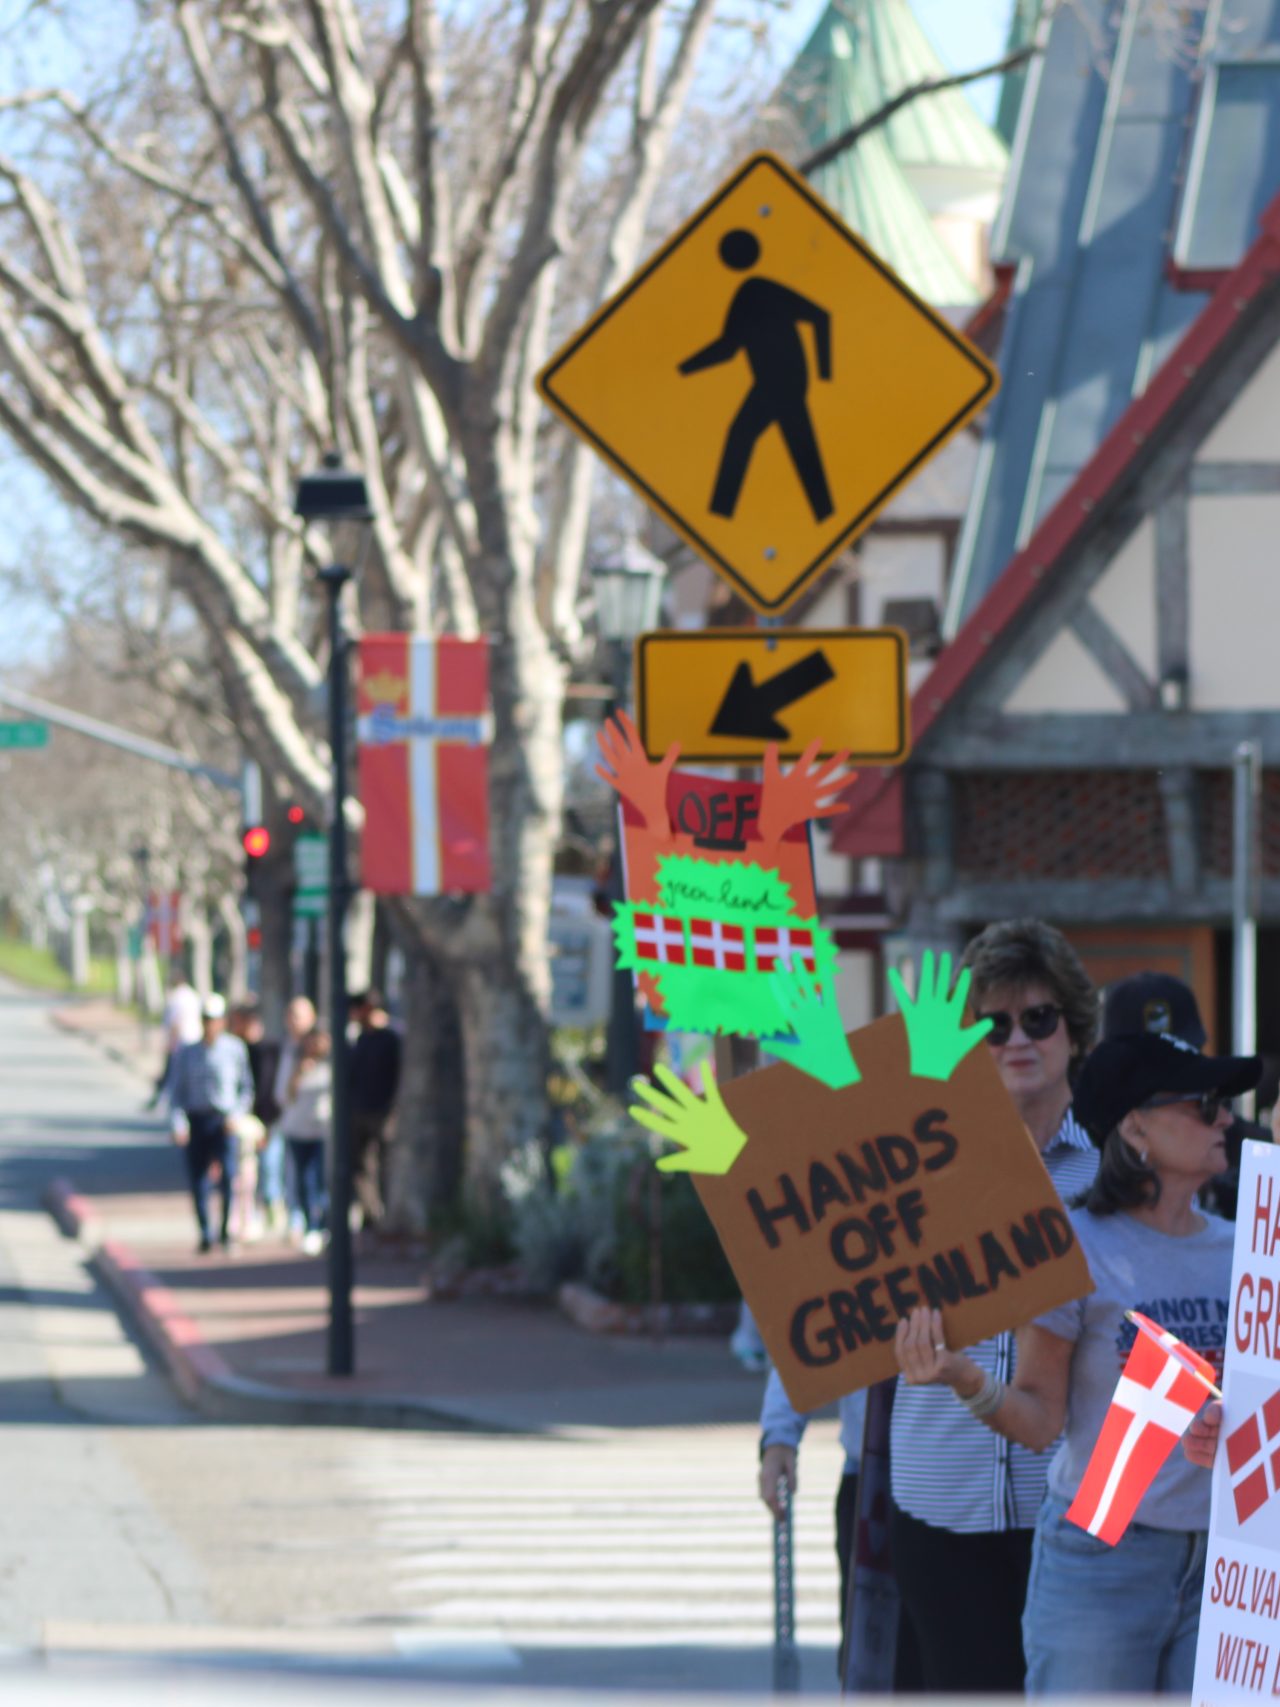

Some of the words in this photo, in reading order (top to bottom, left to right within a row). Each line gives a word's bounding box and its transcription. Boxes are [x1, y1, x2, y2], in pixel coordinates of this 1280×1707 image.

[678, 790, 758, 843] OFF
[746, 1108, 958, 1249] HANDS
[830, 1188, 926, 1273] OFF
[789, 1206, 1075, 1368] GREENLAND
[1160, 1298, 1209, 1323] NOT
[1214, 1631, 1269, 1692] WITH
